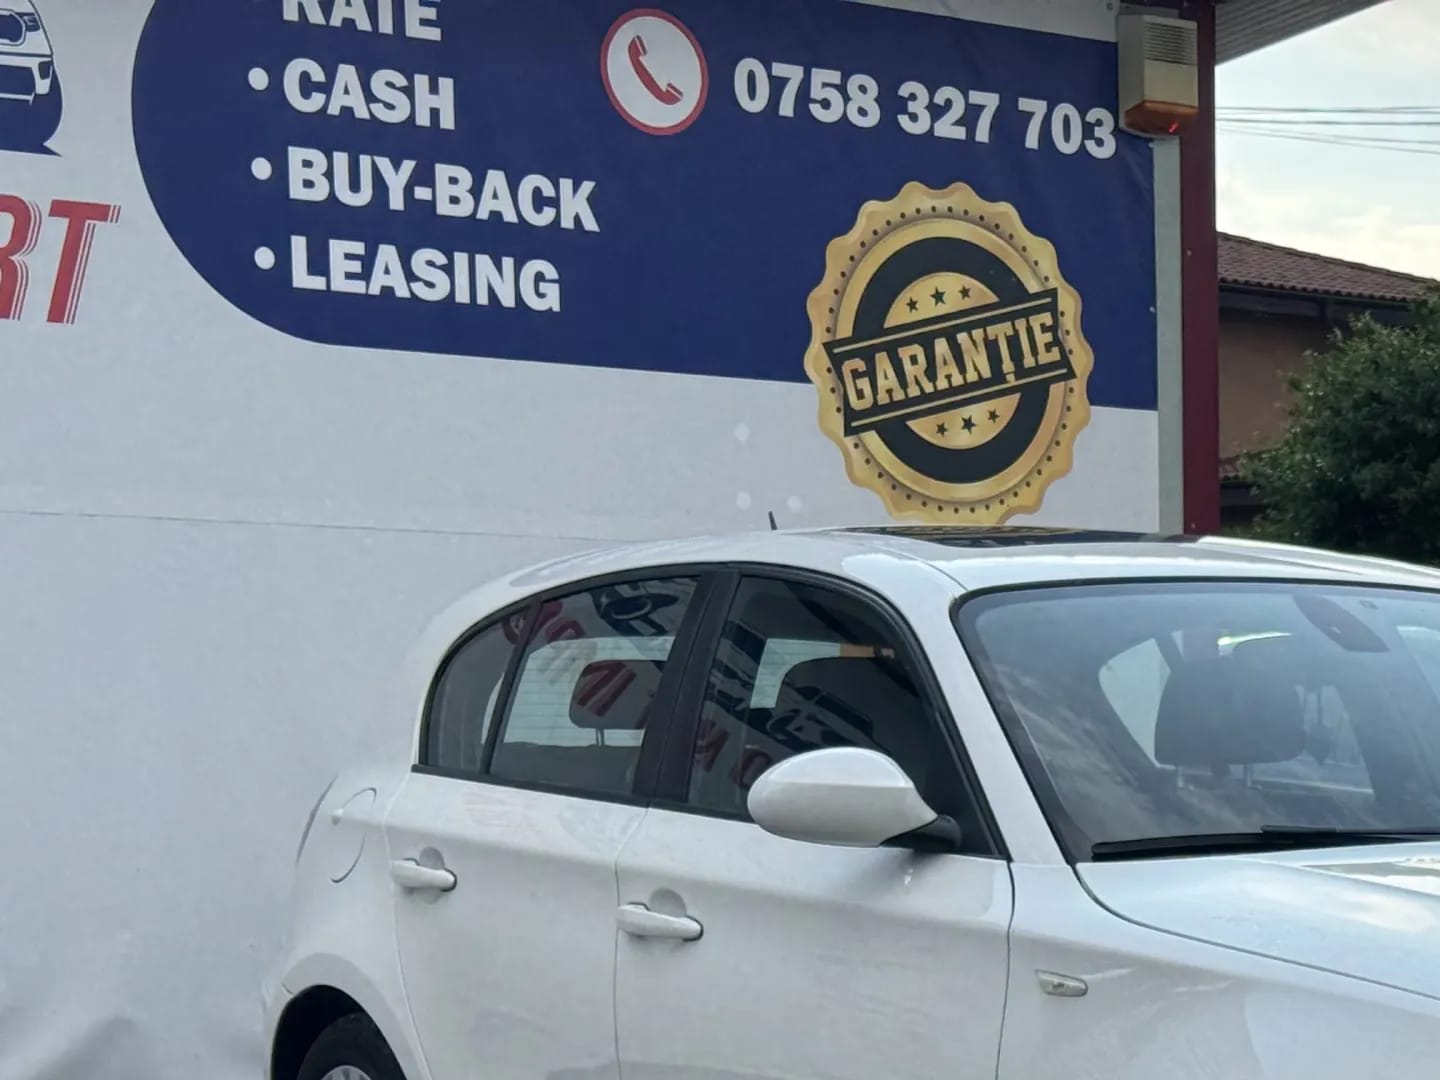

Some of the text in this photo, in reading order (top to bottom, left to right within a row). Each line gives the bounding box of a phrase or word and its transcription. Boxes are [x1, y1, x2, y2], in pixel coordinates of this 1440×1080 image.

[283, 57, 455, 130] CASH
[733, 56, 1118, 160] 0758 327 703
[287, 146, 601, 232] BUY-BACK
[290, 235, 562, 313] LEASING
